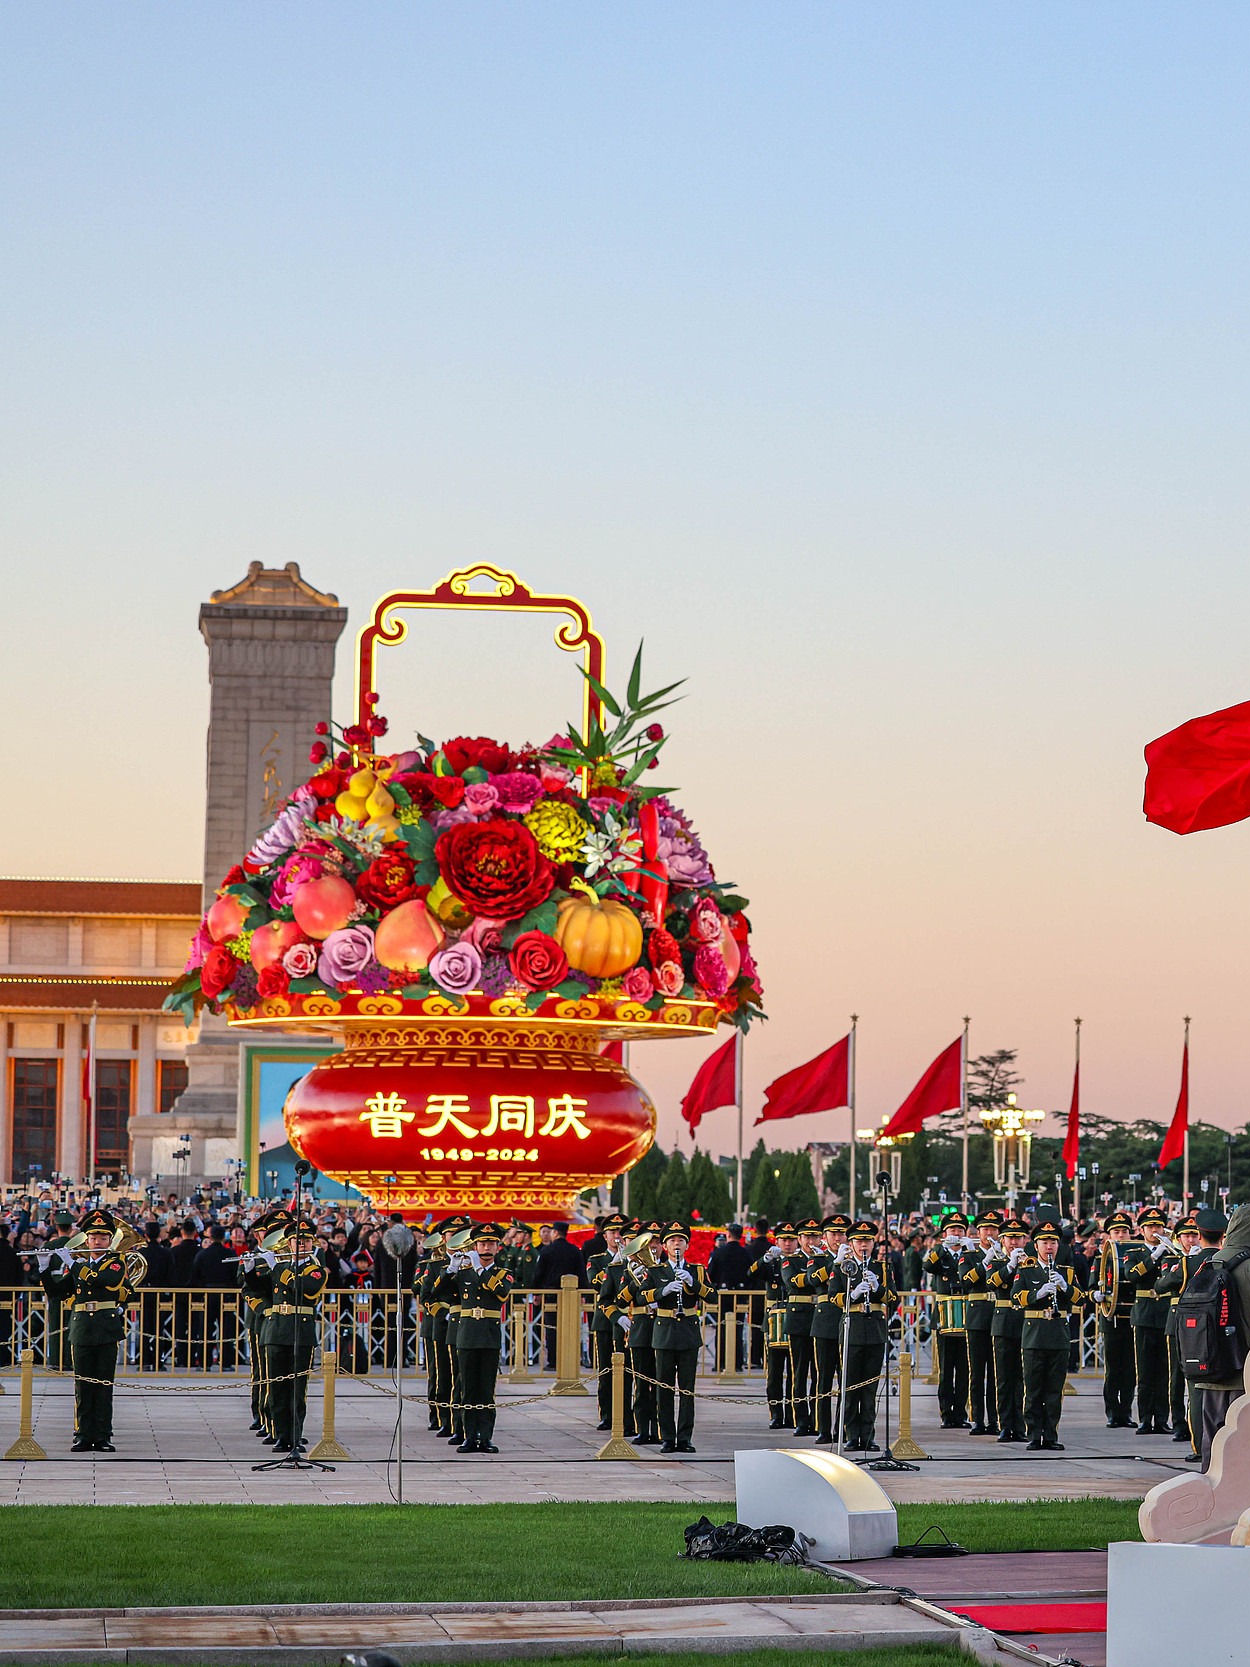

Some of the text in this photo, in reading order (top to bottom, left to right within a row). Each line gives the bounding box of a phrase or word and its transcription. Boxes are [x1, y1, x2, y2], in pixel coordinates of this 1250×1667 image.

[358, 1091, 592, 1140] 普天同庆
[420, 1148, 539, 1162] 1949-2024
[1219, 1288, 1229, 1326] CHINA
